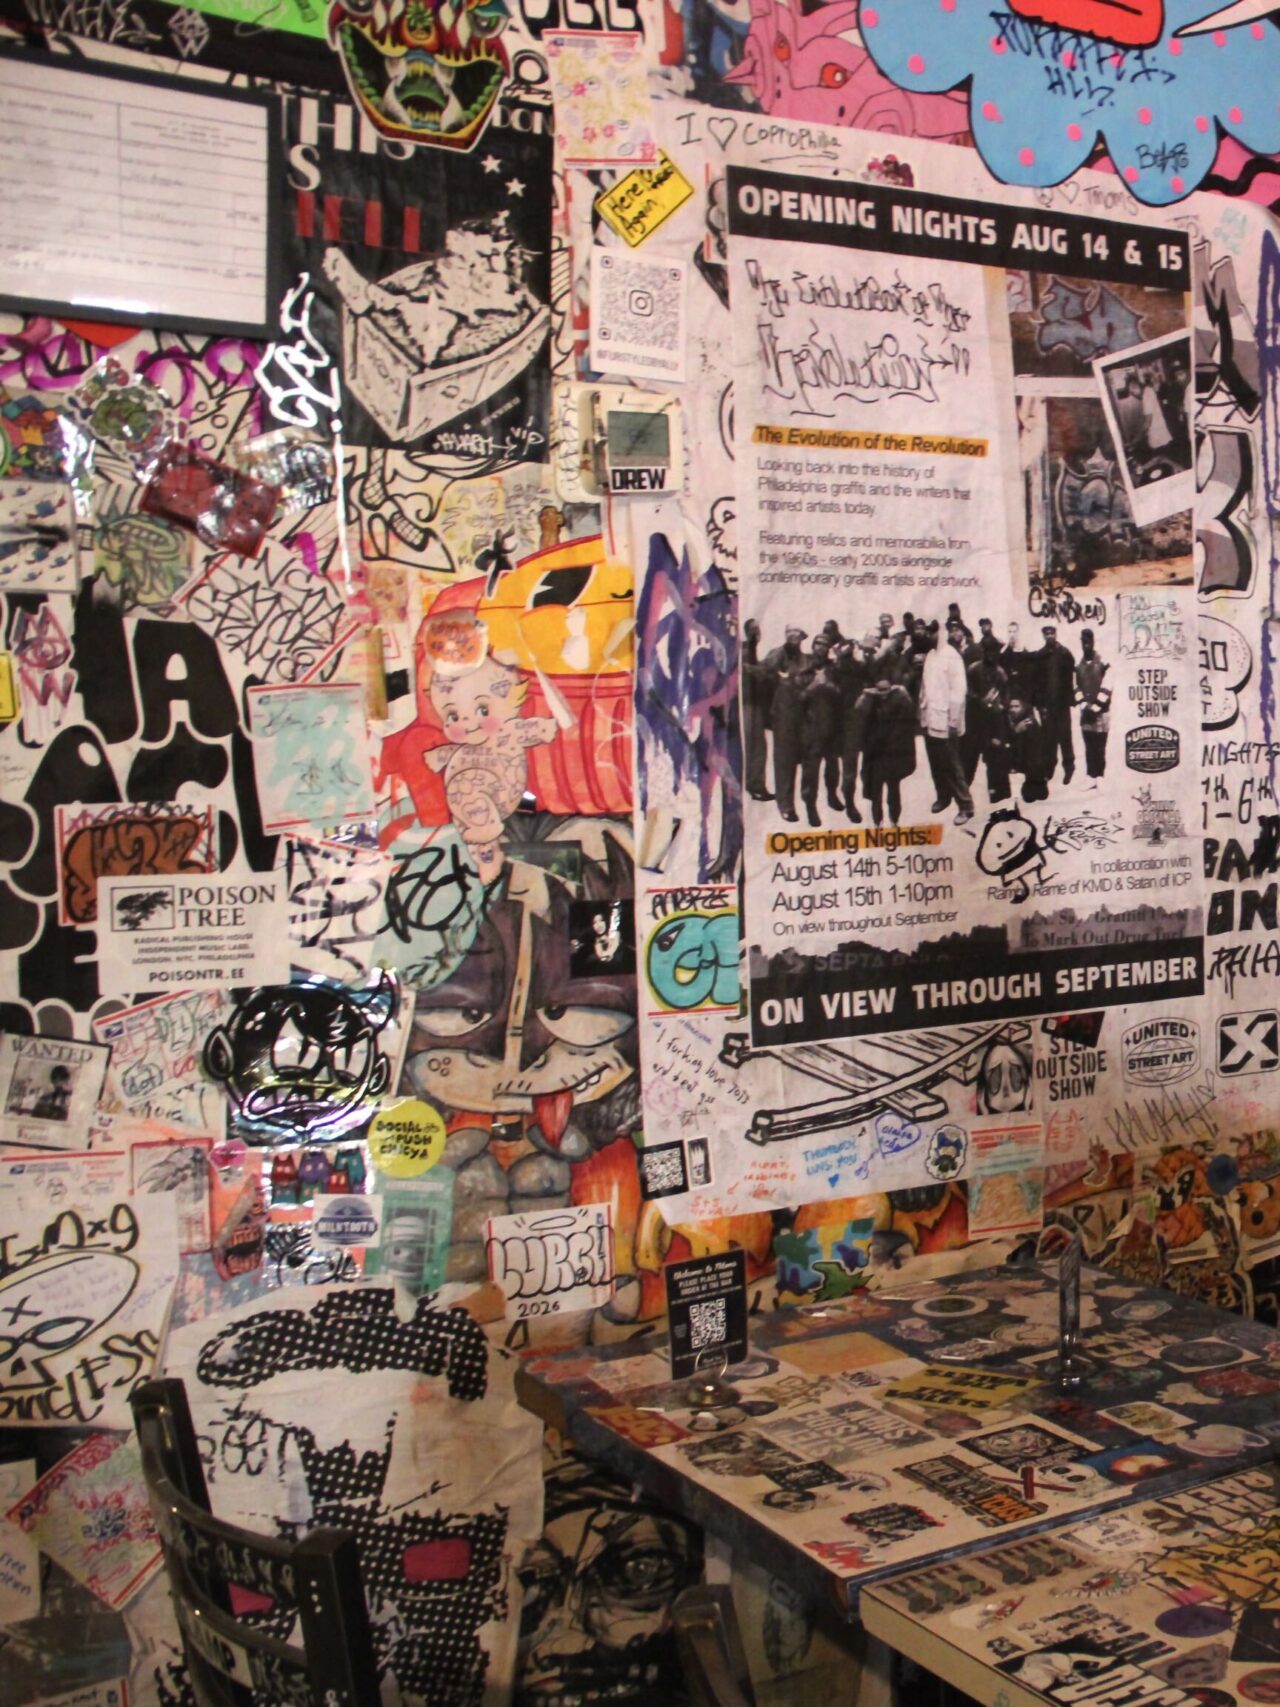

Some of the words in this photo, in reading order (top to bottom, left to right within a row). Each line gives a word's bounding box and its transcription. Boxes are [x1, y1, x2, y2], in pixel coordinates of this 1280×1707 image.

[676, 112, 703, 146] I
[738, 185, 877, 229] OPENING
[891, 211, 998, 245] NIGHTS
[1012, 223, 1069, 255] AUG
[1082, 233, 1109, 259] 14
[1123, 241, 1143, 265] &
[1158, 244, 1183, 270] 15
[755, 426, 783, 445] The
[787, 428, 860, 449] Evolution
[864, 434, 881, 450] of
[884, 435, 907, 451] the
[911, 436, 986, 457] Revolution
[611, 467, 667, 490] DREW
[756, 457, 803, 476] Looking
[805, 461, 835, 474] back
[838, 463, 859, 476] into
[862, 463, 881, 476] the
[883, 464, 921, 481] history
[924, 466, 936, 479] of
[757, 477, 828, 496] Philadelphia
[830, 481, 865, 497] graffiti
[868, 482, 891, 497] and
[893, 482, 913, 497] the
[915, 484, 951, 501] writers
[953, 487, 972, 501] that
[758, 499, 803, 517] inspired
[806, 501, 842, 514] artists
[758, 531, 814, 549] Featuring
[816, 533, 847, 547] relics
[850, 534, 873, 548] and
[875, 536, 945, 550] memorabilia
[947, 536, 972, 551] from
[759, 553, 779, 564] the
[829, 555, 859, 569] early
[861, 553, 899, 568] 2000s
[901, 556, 953, 571] alongside
[759, 570, 842, 588] contemporary
[843, 572, 880, 588] graffiti
[881, 573, 915, 587] artists
[1137, 669, 1169, 684] STEP
[1128, 685, 1178, 701] OUTSIDE
[1137, 702, 1171, 718] SHOW
[1131, 727, 1174, 741] UNITED
[1128, 750, 1158, 760] STREET
[1159, 749, 1177, 760] ART
[770, 831, 860, 857] Opening
[864, 826, 933, 852] Nights:
[771, 860, 840, 887] August
[843, 855, 881, 878] 14th
[885, 854, 954, 878] 5-10pm
[1090, 860, 1102, 874] In
[1104, 858, 1170, 873] collaboration
[1170, 855, 1192, 868] with
[1069, 880, 1081, 894] of
[1082, 878, 1113, 894] KMD
[1114, 877, 1124, 891] &
[1126, 875, 1158, 891] Satan
[1159, 873, 1171, 888] of
[1171, 872, 1193, 887] ICP
[178, 883, 277, 907] POISON
[771, 890, 840, 917] August
[844, 886, 883, 907] 15th
[888, 882, 954, 906] 1-10pm
[177, 907, 247, 929] TREE
[1206, 882, 1279, 937] ON
[772, 920, 795, 937] On
[799, 919, 826, 935] view
[827, 914, 893, 934] throughout
[895, 909, 960, 929] September
[133, 935, 171, 945] RADICAL
[171, 933, 225, 944] PUBLISHING
[225, 932, 254, 942] HOUSE
[199, 944, 227, 952] MUSIC
[228, 942, 251, 951] LABEL
[1023, 932, 1041, 948] To
[1044, 930, 1078, 947] Mark
[1082, 928, 1110, 946] Out
[197, 952, 256, 962] PHILADELPHIA
[148, 967, 247, 983] POISONTR.EE
[760, 996, 802, 1028] ON
[820, 986, 897, 1019] VIEW
[911, 971, 1042, 1011] THROUGH
[1055, 956, 1198, 995] SEPTEMBER
[1132, 1020, 1190, 1046] UNITED
[12, 1038, 95, 1063] WANTED
[1127, 1052, 1170, 1071] STREET
[1171, 1050, 1195, 1066] ART
[704, 1064, 727, 1088] love
[1036, 1050, 1108, 1080] OUTSIDE
[1048, 1074, 1097, 1102] SHOW
[394, 1133, 433, 1146] PUSH
[516, 1300, 561, 1318] 2026
